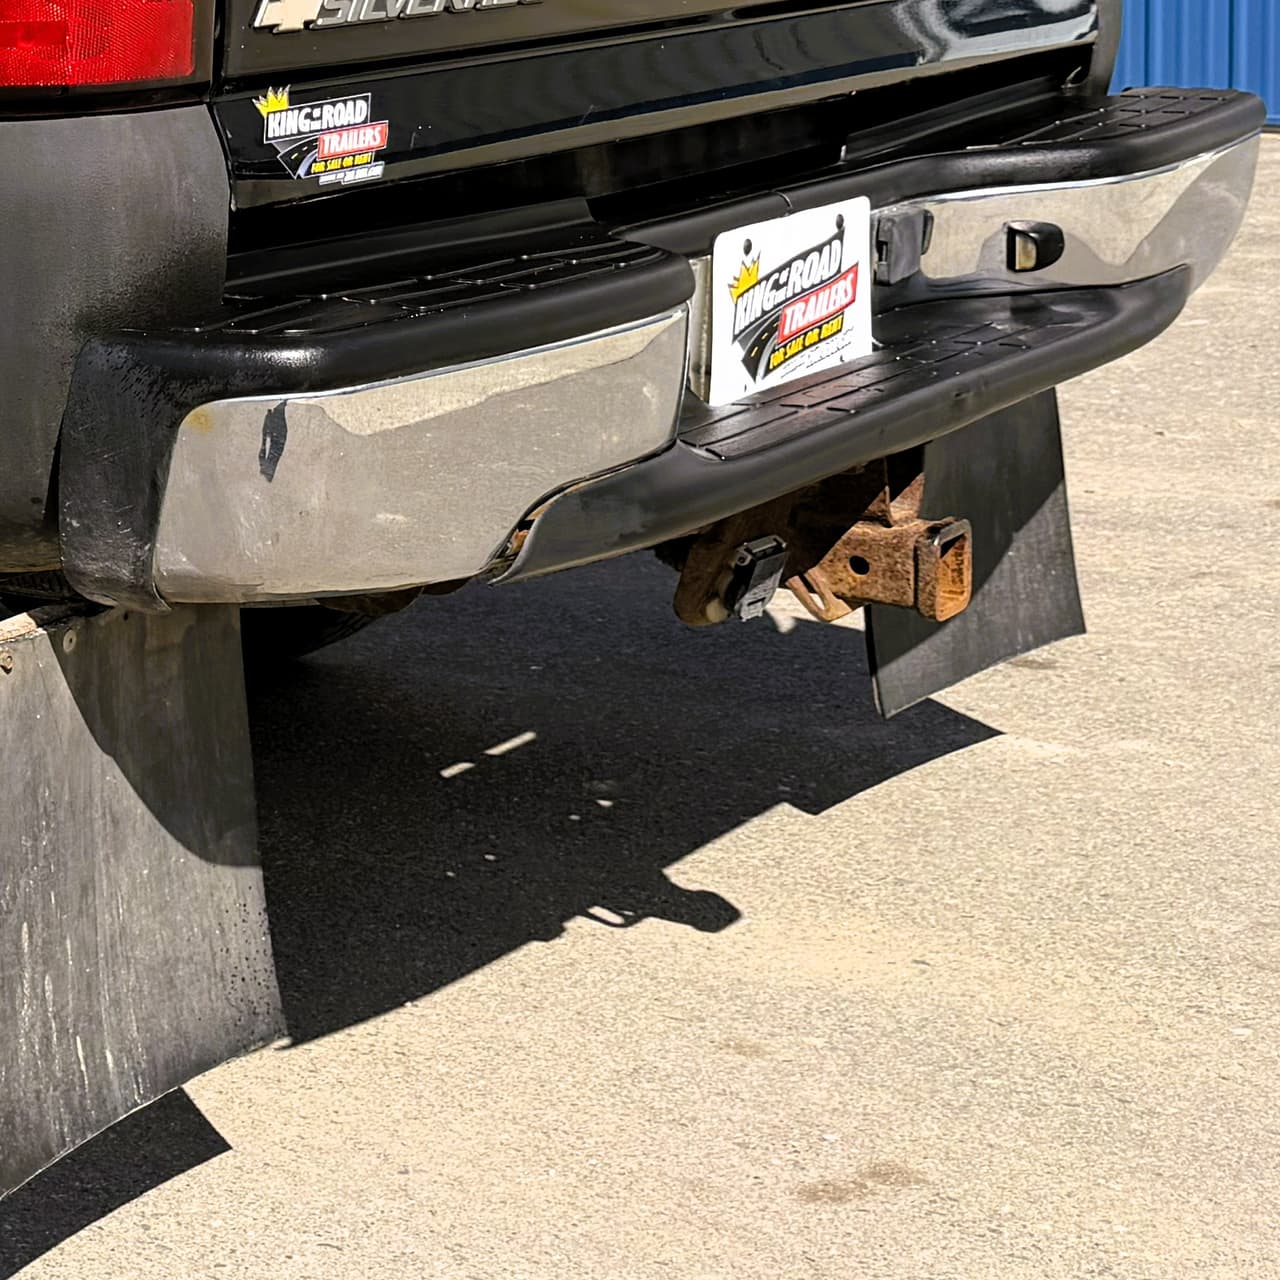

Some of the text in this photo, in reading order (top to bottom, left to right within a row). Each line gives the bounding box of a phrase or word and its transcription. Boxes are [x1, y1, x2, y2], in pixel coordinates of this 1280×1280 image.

[267, 107, 312, 138] KING
[321, 99, 368, 130] ROAD
[322, 126, 382, 154] TRAILERS
[734, 272, 779, 336] KING
[787, 239, 842, 298] ROAD
[783, 272, 854, 336] TRAILERS
